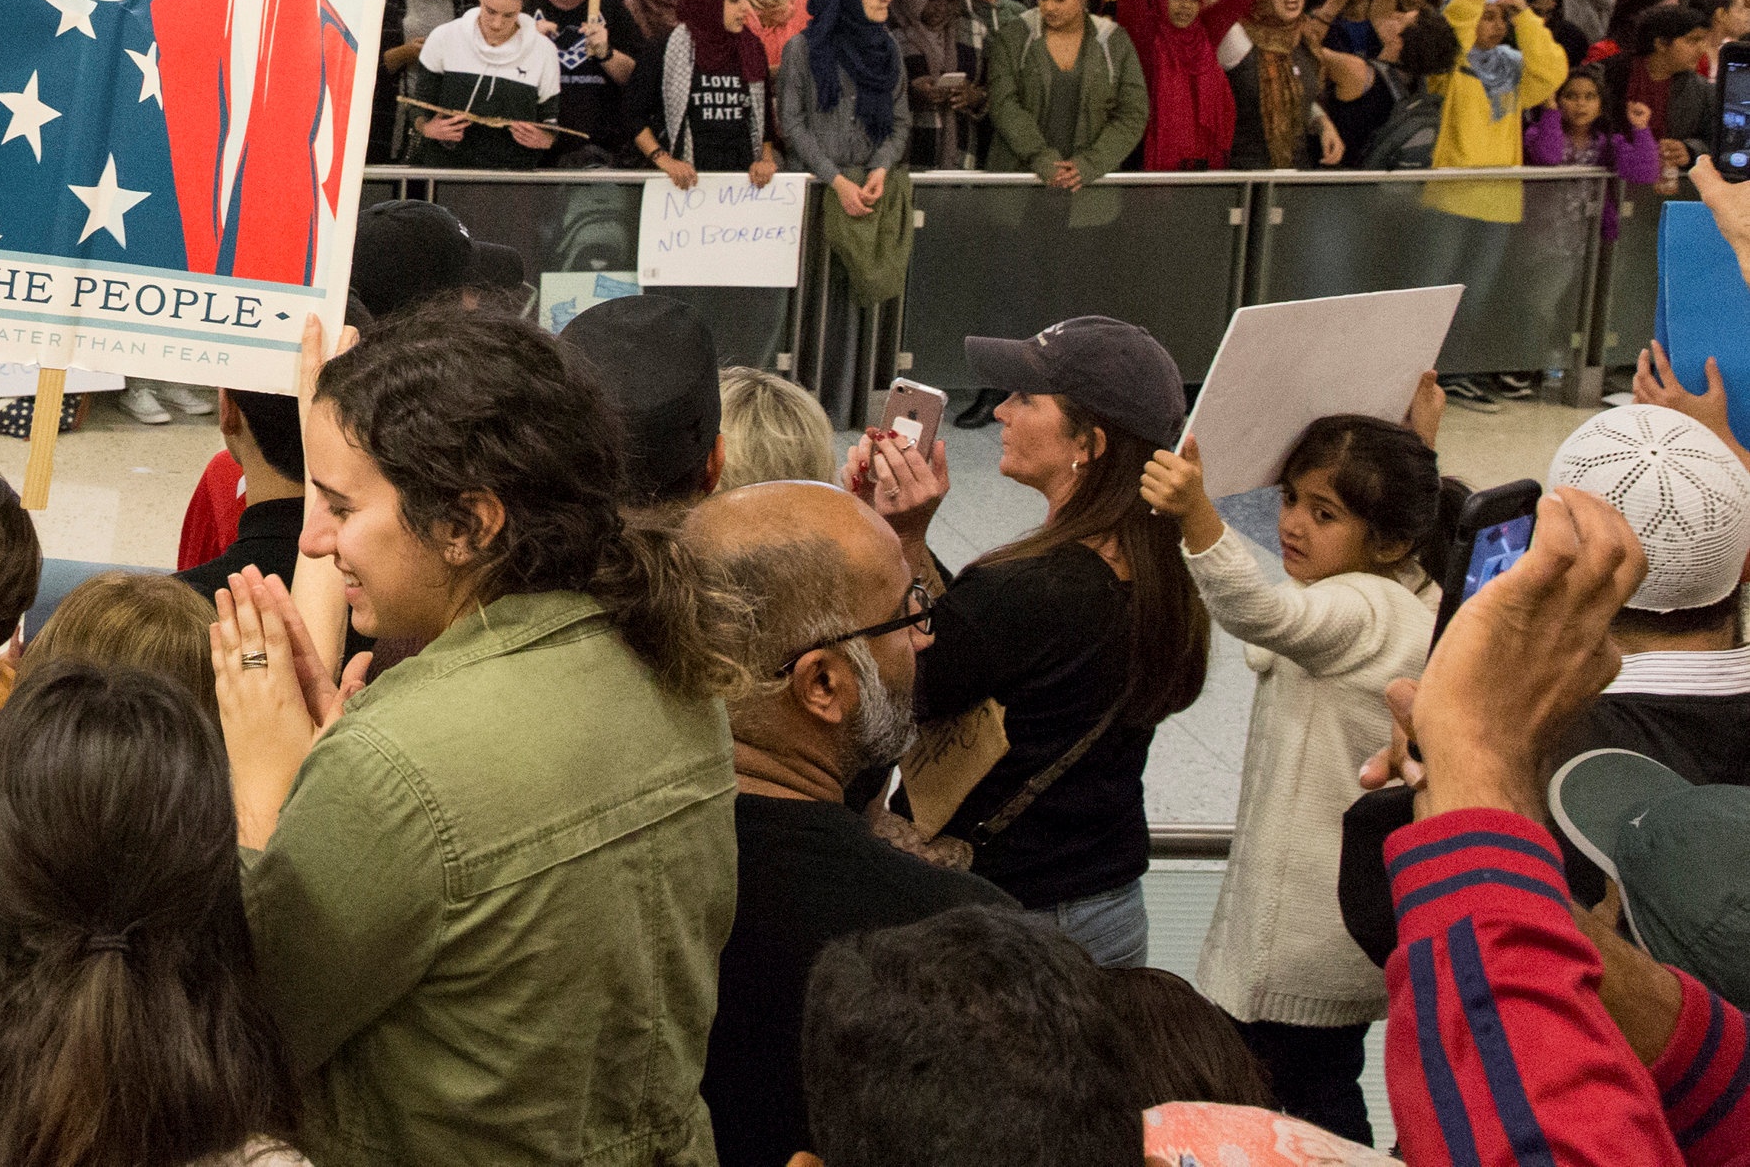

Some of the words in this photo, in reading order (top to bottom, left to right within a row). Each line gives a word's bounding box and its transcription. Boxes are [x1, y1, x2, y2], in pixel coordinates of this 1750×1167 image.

[701, 74, 742, 89] LOVE
[703, 108, 743, 120] HATE
[663, 189, 706, 221] NO
[718, 182, 797, 206] WALLS
[658, 230, 691, 252] NO
[701, 224, 798, 246] BORDERS
[70, 276, 264, 329] PEOPLE
[75, 334, 154, 355] THAN
[162, 345, 230, 367] FEAR
